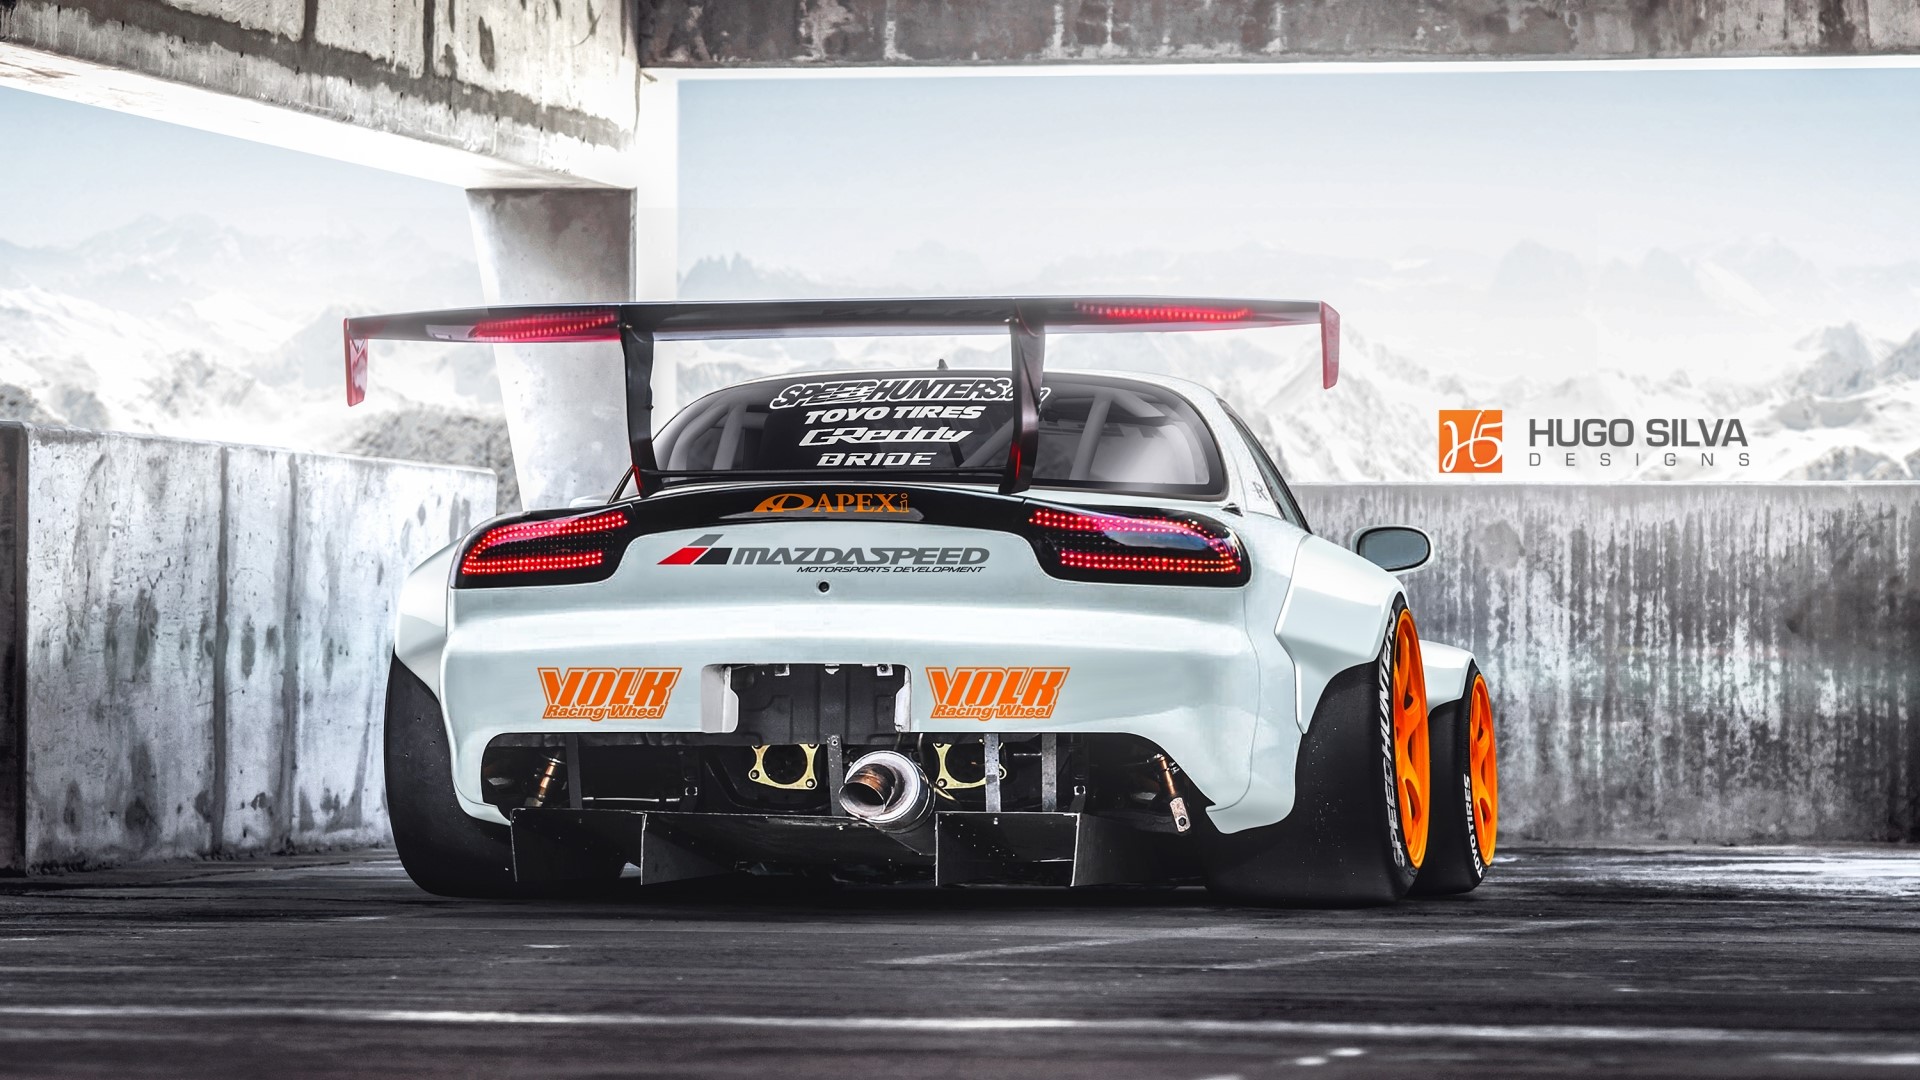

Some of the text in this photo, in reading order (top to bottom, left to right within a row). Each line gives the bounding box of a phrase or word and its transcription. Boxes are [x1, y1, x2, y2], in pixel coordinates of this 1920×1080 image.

[804, 405, 987, 425] TOYO TIRES
[816, 452, 937, 467] BRIDE
[733, 547, 990, 565] MAZDASPEED
[537, 667, 682, 706] VOLK
[925, 667, 1070, 706] VOLK
[1463, 773, 1483, 879] TOYO TIRES
